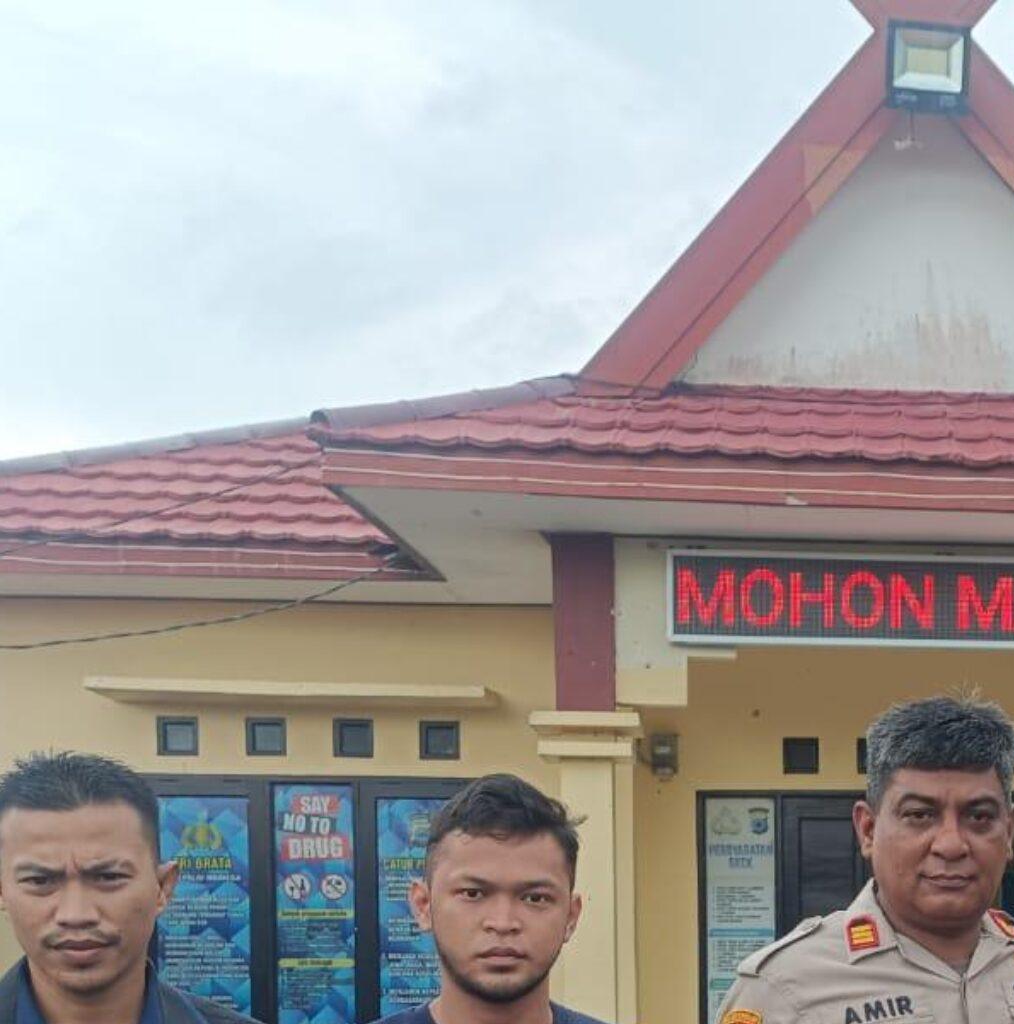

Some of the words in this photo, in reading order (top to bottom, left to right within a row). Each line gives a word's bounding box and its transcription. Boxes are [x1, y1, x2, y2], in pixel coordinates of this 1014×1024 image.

[676, 566, 934, 629] MOHON
[300, 795, 330, 815] SAY
[283, 813, 306, 832] NO
[310, 816, 331, 835] TO
[288, 837, 342, 859] DRUG
